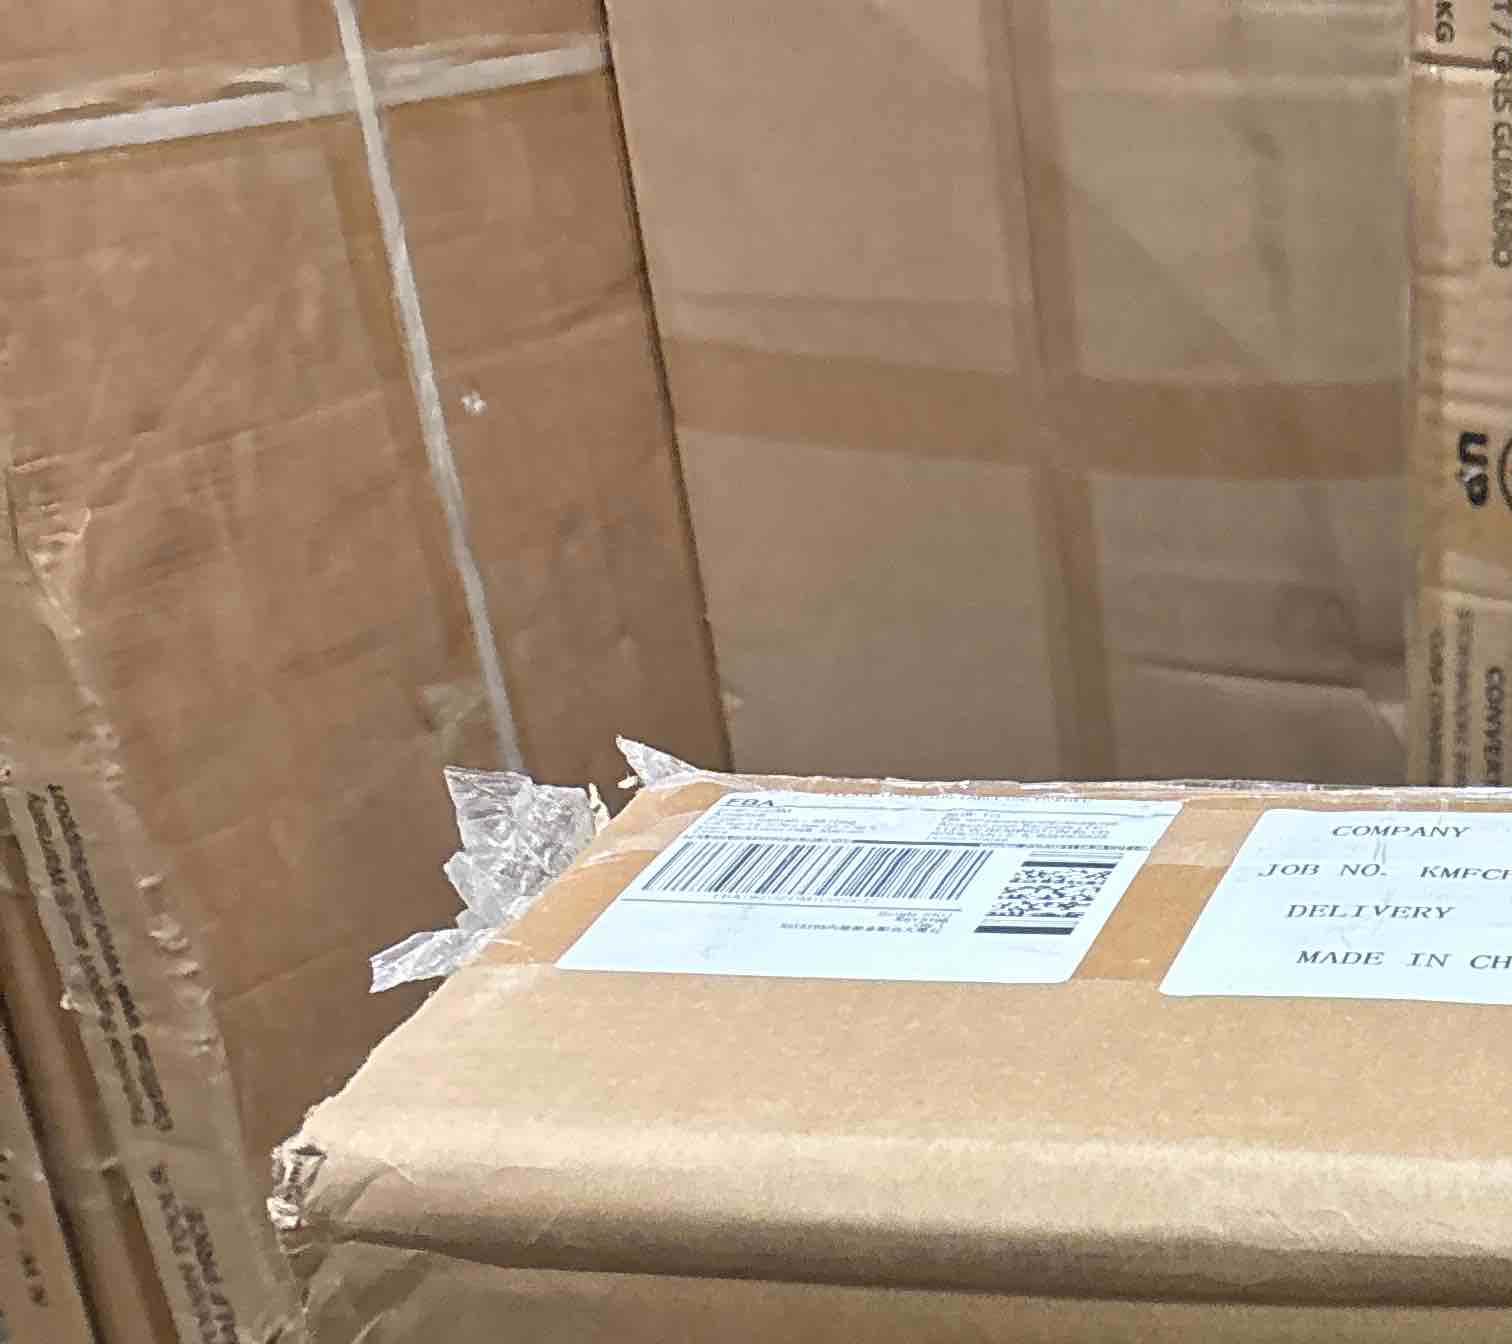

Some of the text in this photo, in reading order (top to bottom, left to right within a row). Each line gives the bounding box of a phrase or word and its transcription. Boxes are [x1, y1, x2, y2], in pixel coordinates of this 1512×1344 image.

[1458, 431, 1489, 507] UP
[1331, 825, 1471, 840] COMPANY
[1257, 863, 1320, 878] JOB
[1340, 863, 1388, 878] NO.
[1285, 904, 1456, 920] DELIVERY
[1295, 949, 1385, 966] MADE
[1405, 952, 1452, 968] IN
